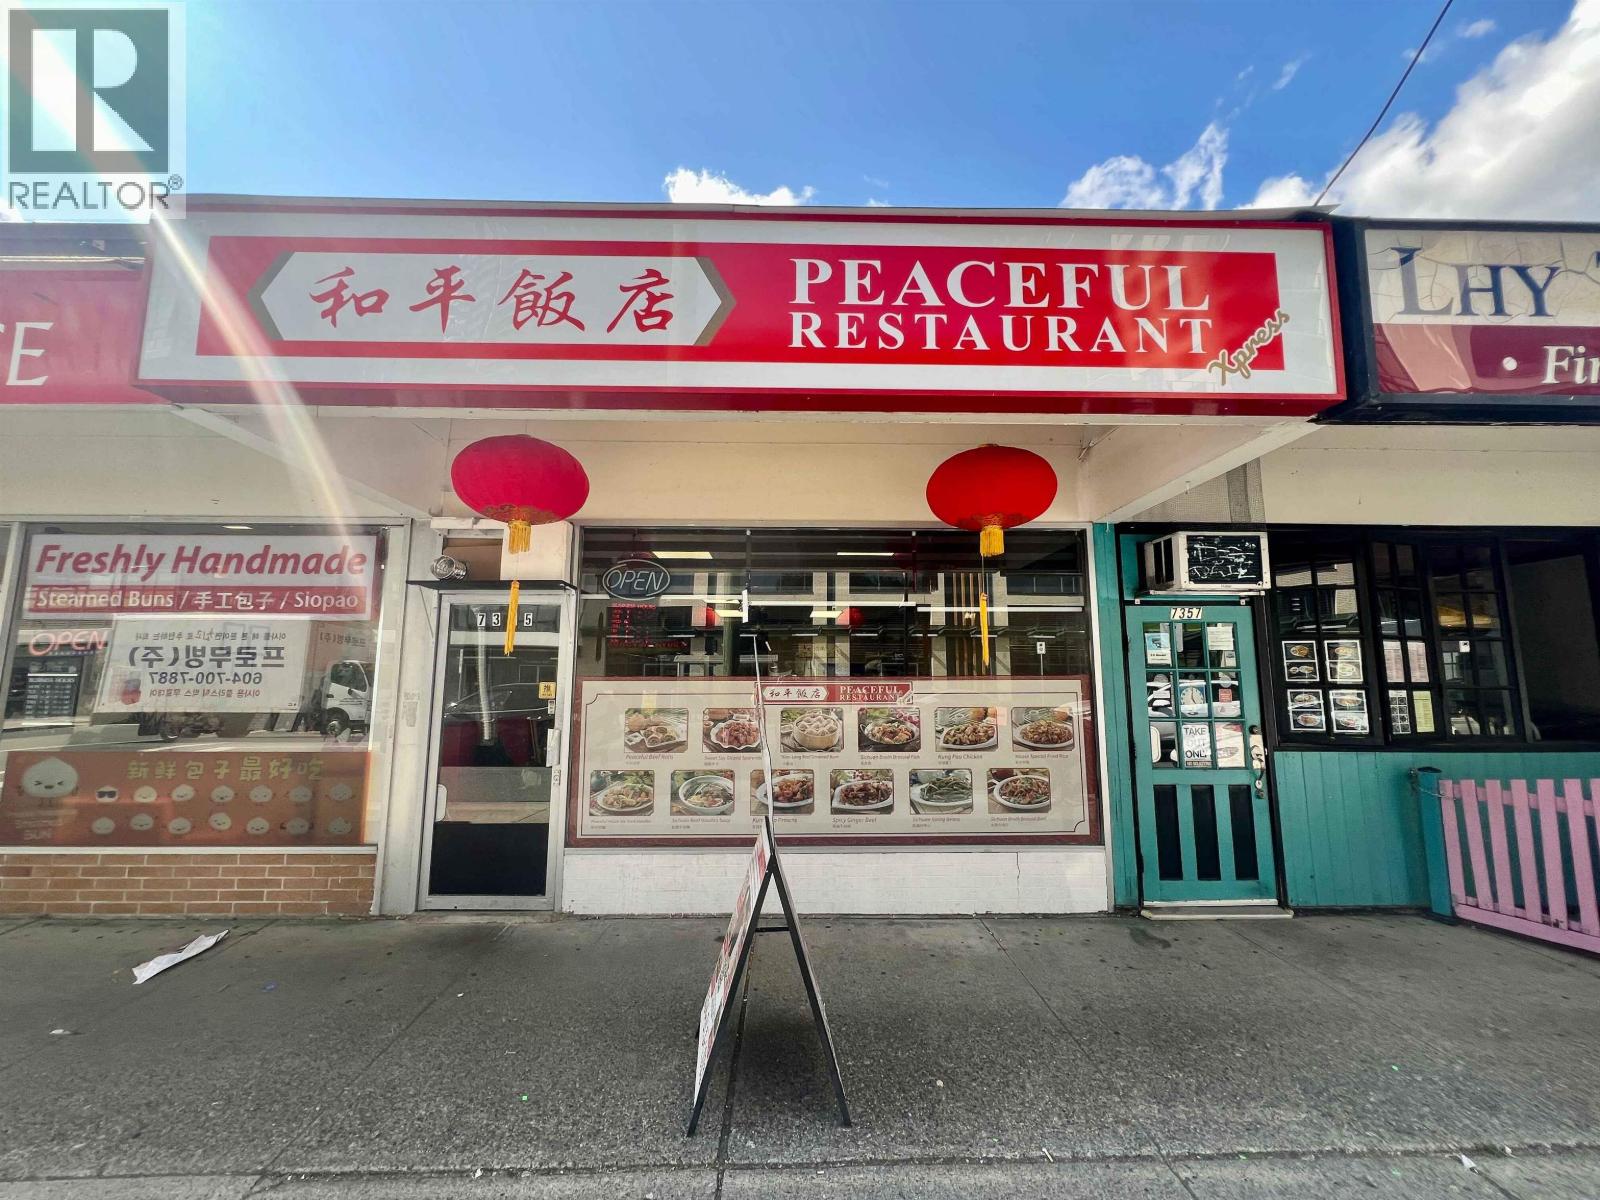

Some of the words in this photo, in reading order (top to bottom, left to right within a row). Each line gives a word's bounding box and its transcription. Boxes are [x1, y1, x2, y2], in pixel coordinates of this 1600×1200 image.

[308, 264, 675, 335] 和平飯店
[788, 257, 1210, 312] PEACEFUL
[1390, 246, 1561, 317] LHY
[787, 310, 1213, 355] RESTAURANT
[1206, 308, 1290, 386] Xpress
[0, 321, 54, 386] E
[35, 543, 166, 582] Freshly
[170, 544, 367, 576] Handmade
[606, 570, 664, 591] OPEN
[37, 590, 123, 608] Steamed
[127, 590, 174, 607] Buns
[194, 590, 276, 610] 手工包子
[293, 591, 359, 612] Siopao
[1172, 608, 1202, 619] 7357
[28, 631, 108, 656] OPEN
[839, 685, 900, 694] PEACEFUL
[1184, 727, 1207, 736] TAKE
